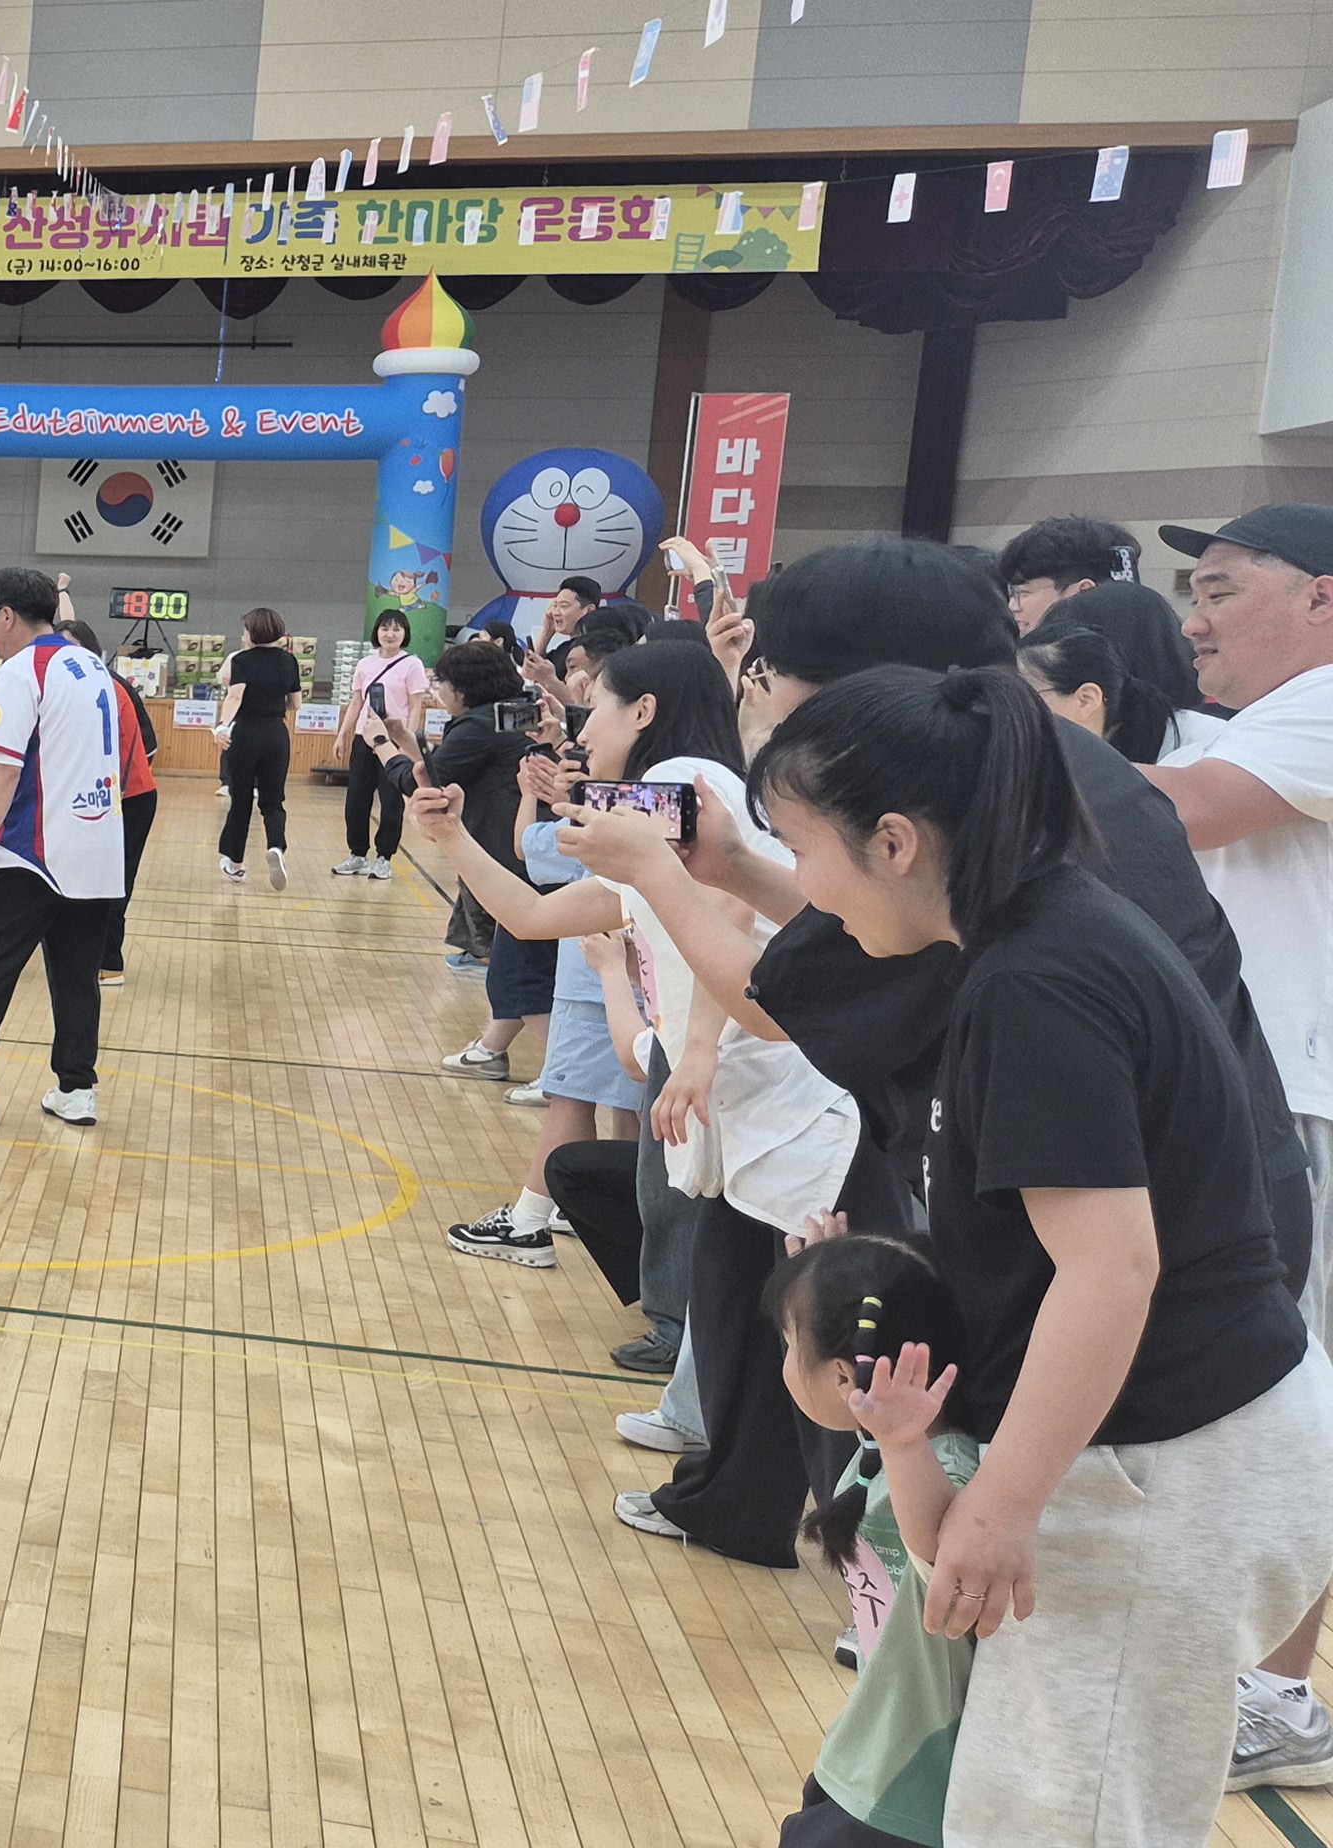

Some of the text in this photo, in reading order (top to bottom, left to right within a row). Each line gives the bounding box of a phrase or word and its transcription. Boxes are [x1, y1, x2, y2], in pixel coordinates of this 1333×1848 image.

[244, 200, 339, 246] 가족
[355, 197, 504, 245] 한마당
[517, 194, 668, 242] 운동회
[7, 258, 33, 276] (금)
[38, 257, 141, 273] 14:00~16:00
[240, 253, 408, 272] 장소: 산청군 실내체육관
[221, 405, 247, 438] &
[256, 407, 364, 437] Event
[96, 688, 113, 756] 1
[72, 788, 112, 810] 스마일
